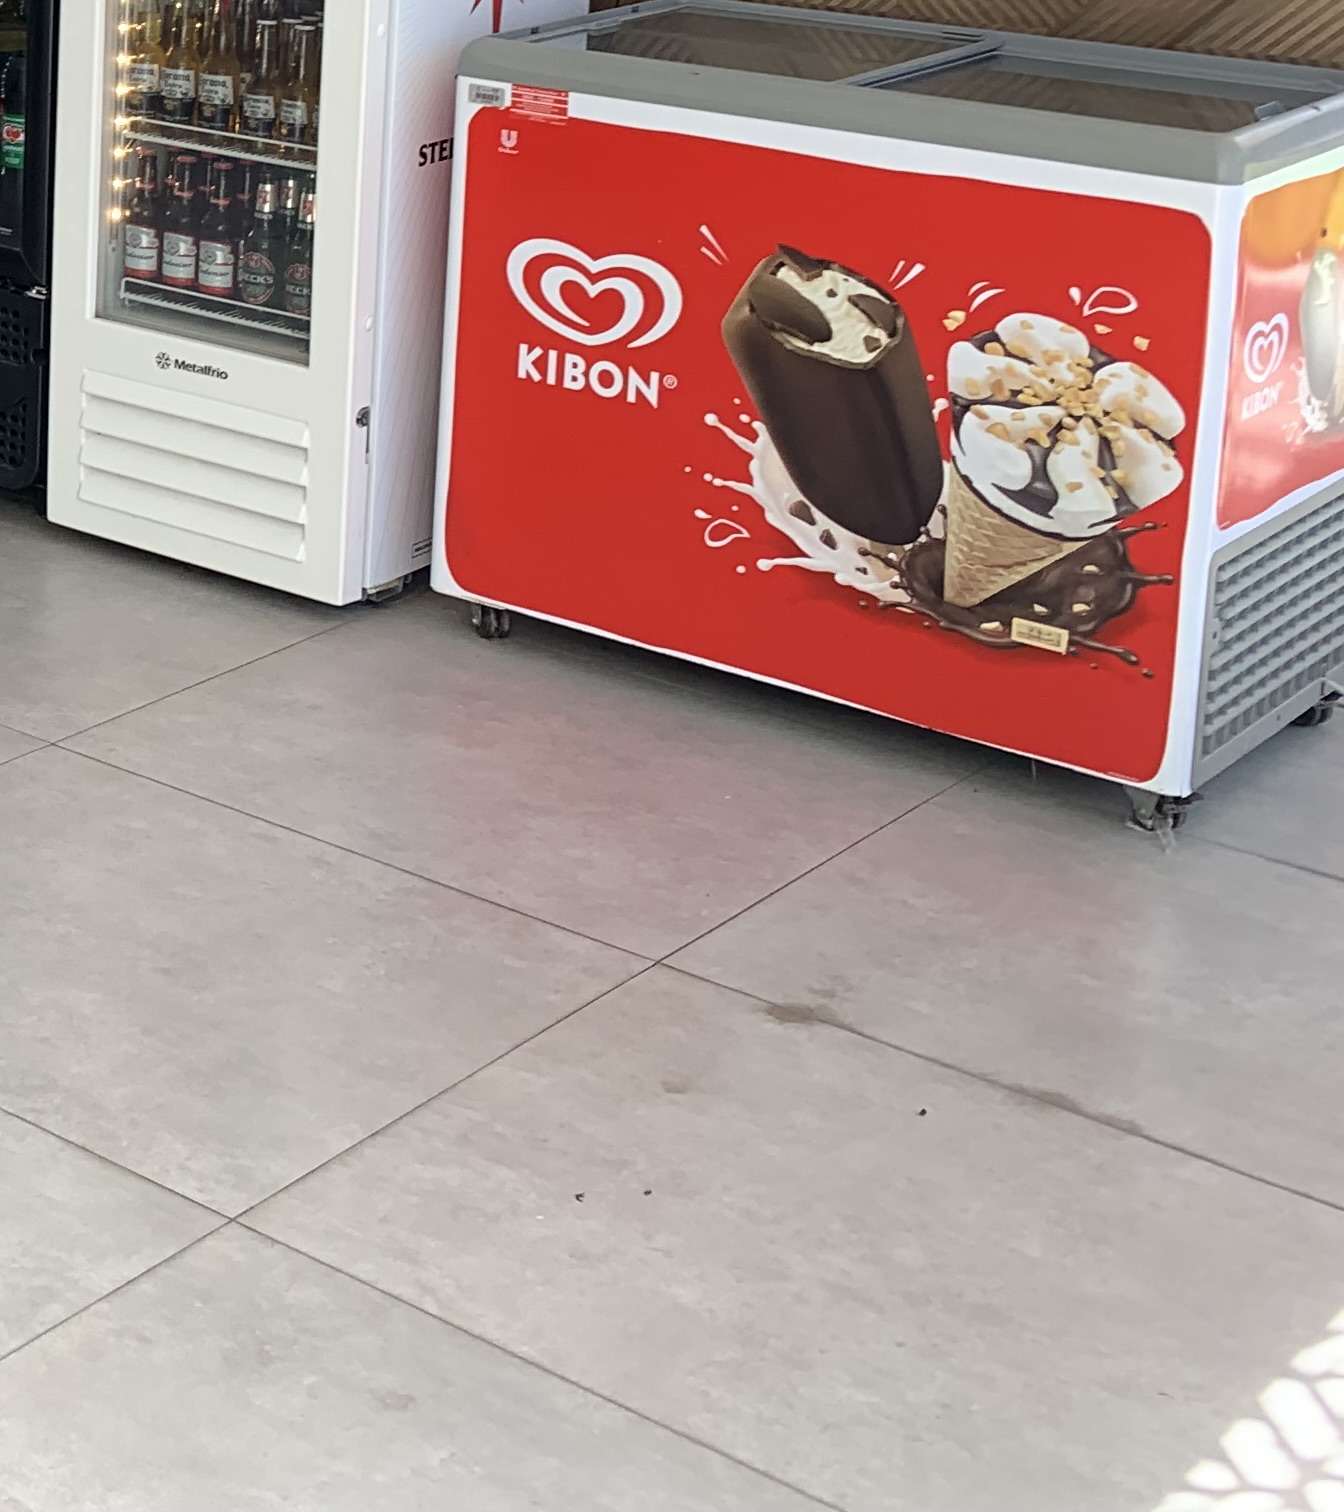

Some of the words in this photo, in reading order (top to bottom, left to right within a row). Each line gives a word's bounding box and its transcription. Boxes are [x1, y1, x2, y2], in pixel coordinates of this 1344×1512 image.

[174, 358, 229, 380] Metalfrio
[517, 343, 661, 409] KIBON
[1241, 389, 1281, 422] KIBON
